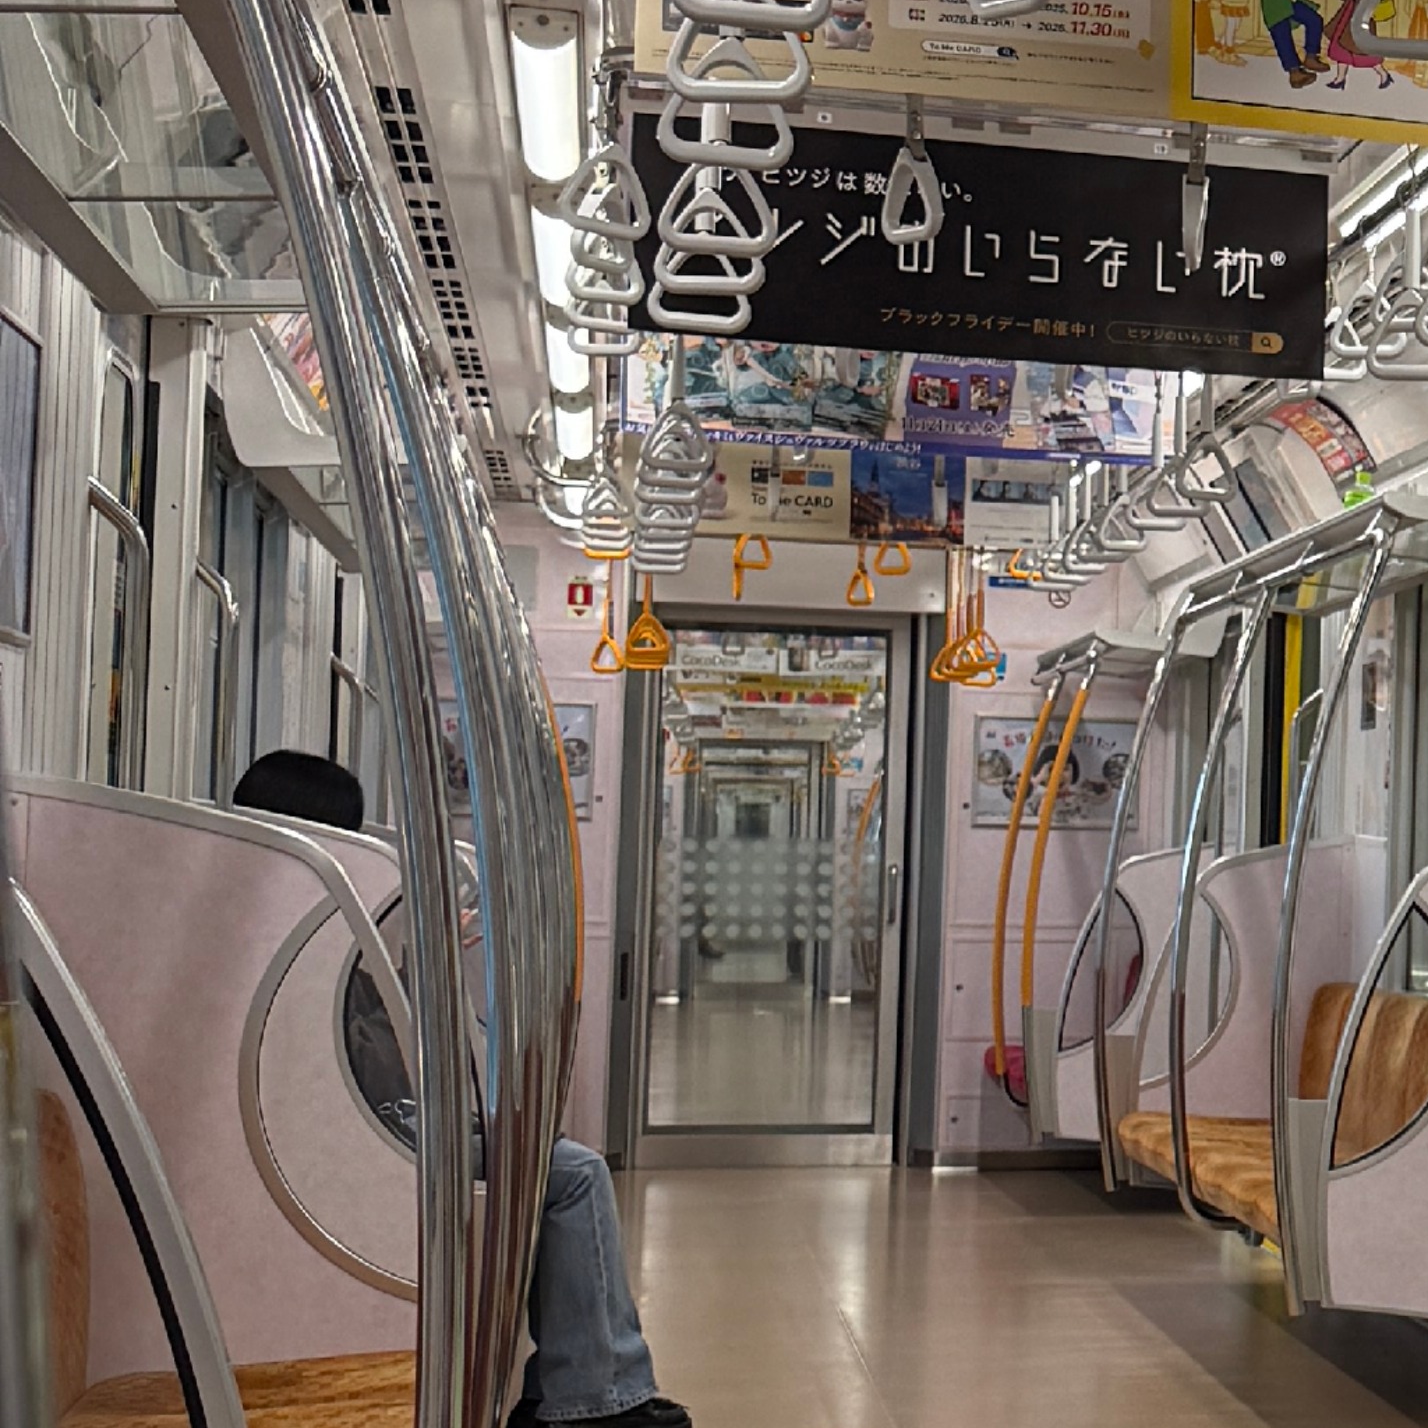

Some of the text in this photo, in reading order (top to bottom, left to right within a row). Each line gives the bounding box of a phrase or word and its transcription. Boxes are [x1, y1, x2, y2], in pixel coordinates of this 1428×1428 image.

[879, 306, 1097, 341] ブラックフライデー開催中!
